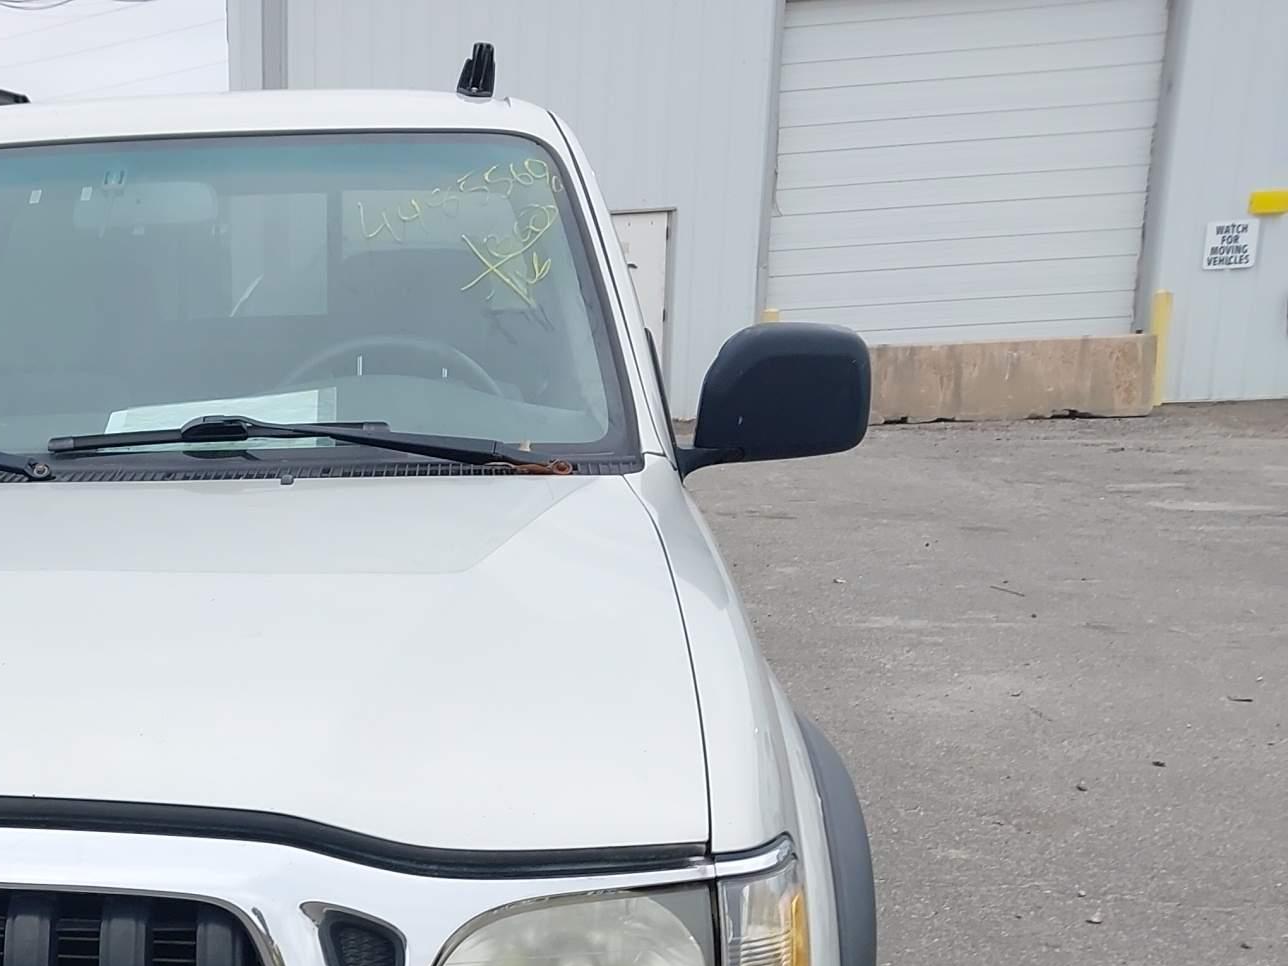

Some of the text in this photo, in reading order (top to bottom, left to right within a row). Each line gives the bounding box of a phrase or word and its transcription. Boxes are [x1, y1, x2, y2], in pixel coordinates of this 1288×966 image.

[1216, 223, 1248, 235] WATCH
[1220, 234, 1240, 245] FOR
[1210, 244, 1248, 255] MOVING
[1207, 255, 1250, 266] VEHICLES
